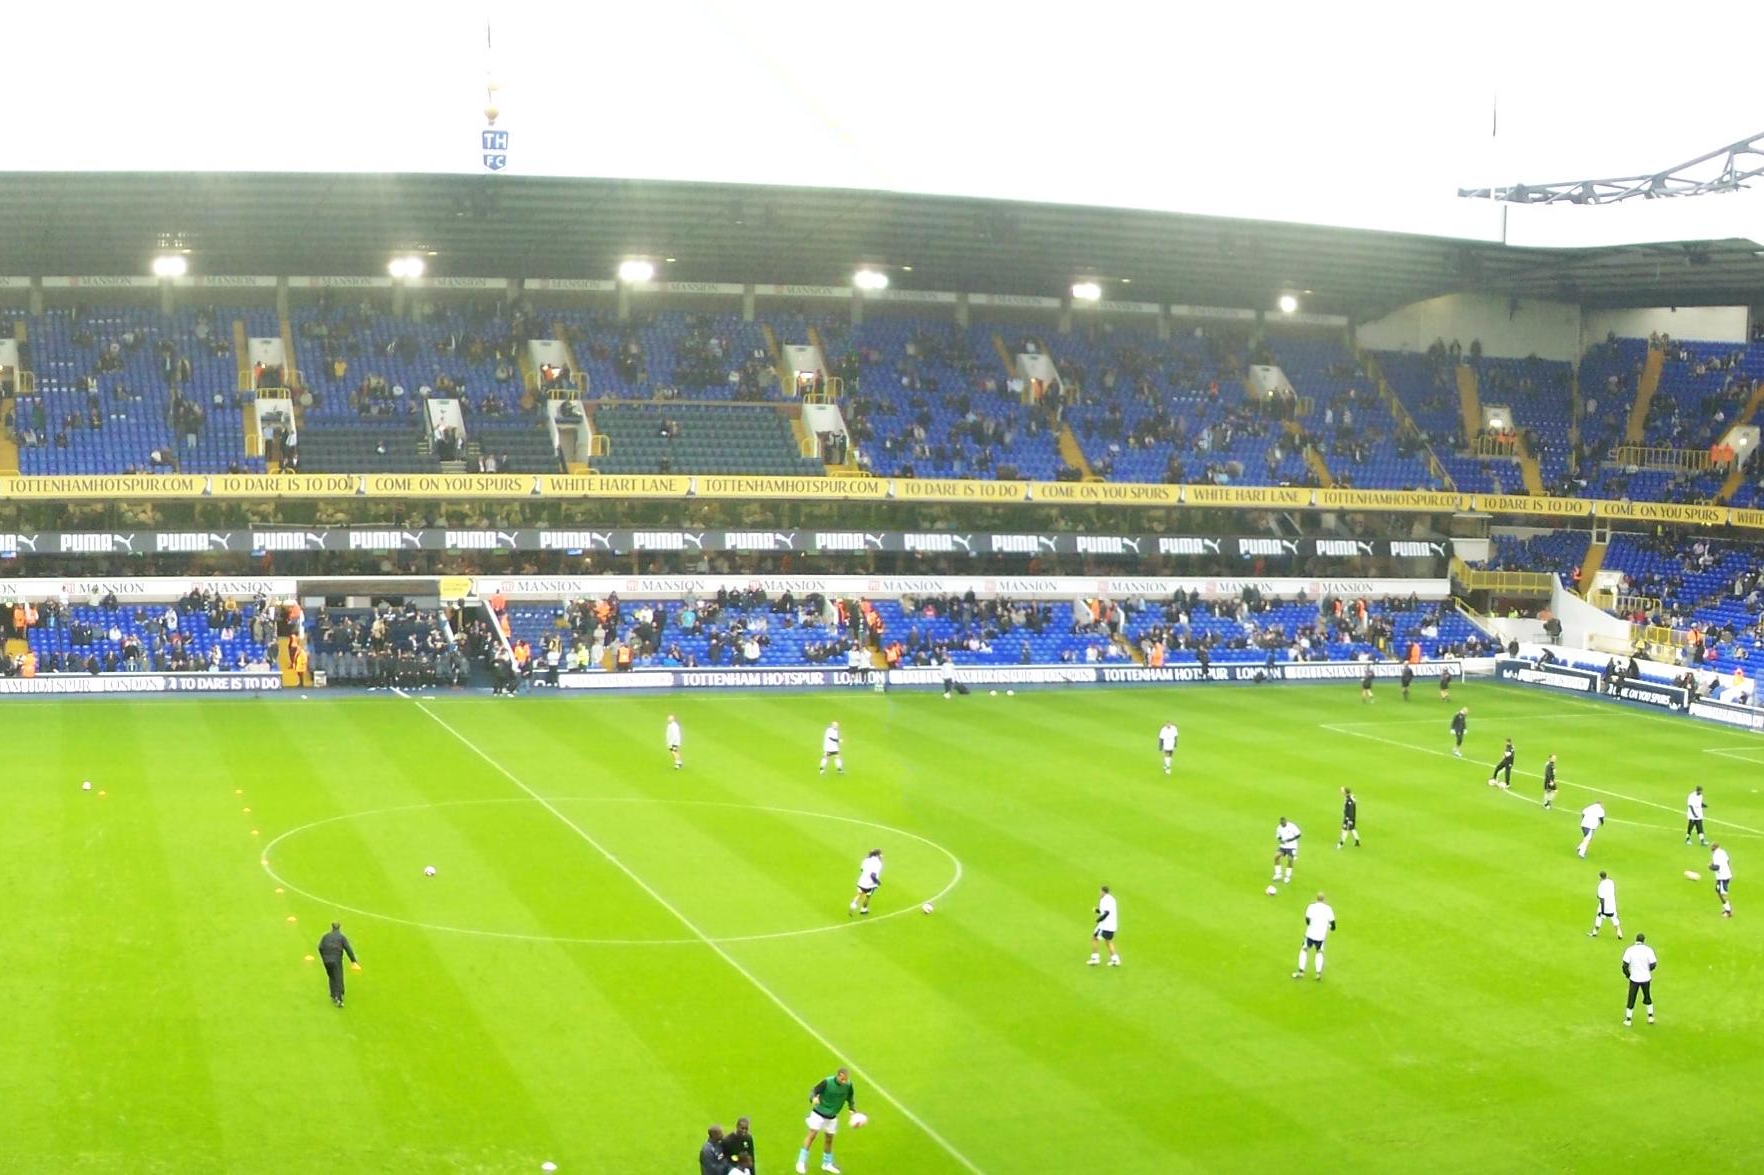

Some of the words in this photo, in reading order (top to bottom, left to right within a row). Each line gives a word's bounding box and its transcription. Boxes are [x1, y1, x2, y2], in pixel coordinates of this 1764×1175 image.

[484, 133, 507, 149] TH
[486, 155, 504, 167] FC
[81, 277, 131, 286] MANSION
[323, 277, 372, 286] MANSION
[437, 278, 486, 288] MANSION
[9, 479, 193, 492] TOTTENHAMHOTSPUR.COM
[224, 479, 240, 491] TO
[245, 478, 283, 491] DARE
[288, 478, 300, 491] IS
[305, 478, 326, 491] TO
[330, 478, 348, 491] DO
[375, 478, 413, 491] COME
[419, 478, 441, 491] ON
[444, 478, 473, 491] YOU
[479, 478, 522, 491] SPURS
[551, 479, 596, 491] WHITE
[600, 479, 637, 491] HART
[642, 479, 677, 492] LANE
[706, 480, 878, 494] TOTTENHAMHOTSPUR.COM
[905, 481, 921, 494] TO
[925, 482, 957, 495] DARE
[964, 483, 974, 496] IS
[979, 484, 995, 496] TO
[999, 485, 1018, 497] DO
[1041, 485, 1076, 498] COME
[1080, 486, 1099, 498] ON
[1102, 486, 1127, 499] YOU
[1130, 487, 1170, 500] SPURS
[1194, 488, 1233, 501] WHITE
[1236, 489, 1267, 502] HART
[1270, 490, 1298, 502] LANE
[1484, 498, 1496, 509] TO
[1499, 499, 1530, 510] DARE
[1533, 500, 1543, 511] IS
[1548, 500, 1561, 512] TO
[1565, 501, 1582, 512] DO
[1604, 503, 1635, 516] COME
[1641, 505, 1657, 517] ON
[1660, 506, 1682, 519] YOU
[1685, 508, 1719, 521] SPURS
[61, 534, 113, 551] PUMA
[157, 534, 209, 550] PUMA
[253, 533, 305, 549] PUMA
[350, 532, 401, 549] PUMA
[445, 532, 497, 548] PUMA
[539, 532, 591, 548] PUMA
[634, 532, 683, 549] PUMA
[725, 533, 774, 549] PUMA
[816, 533, 865, 549] PUMA
[904, 534, 952, 550] PUMA
[991, 535, 1038, 551] PUMA
[1076, 536, 1122, 553] PUMA
[1159, 538, 1203, 554] PUMA
[1239, 539, 1283, 555] PUMA
[1316, 540, 1358, 556] PUMA
[1390, 541, 1431, 556] PUMA
[207, 582, 273, 594] MANSION
[518, 581, 581, 592] MANSION
[642, 580, 704, 591] MANSION
[764, 581, 825, 591] MANSION
[884, 581, 943, 591] MANSION
[1000, 581, 1057, 592] MANSION
[1112, 582, 1167, 592] MANSION
[1323, 582, 1373, 593] MANSION
[683, 673, 760, 686] TOTTENHAM
[763, 672, 824, 685] HOTSPUR
[1103, 668, 1173, 681] TOTTENHAM
[180, 678, 196, 690] TO
[197, 677, 229, 690] DARE
[231, 678, 242, 690] IS
[244, 678, 260, 690] TO
